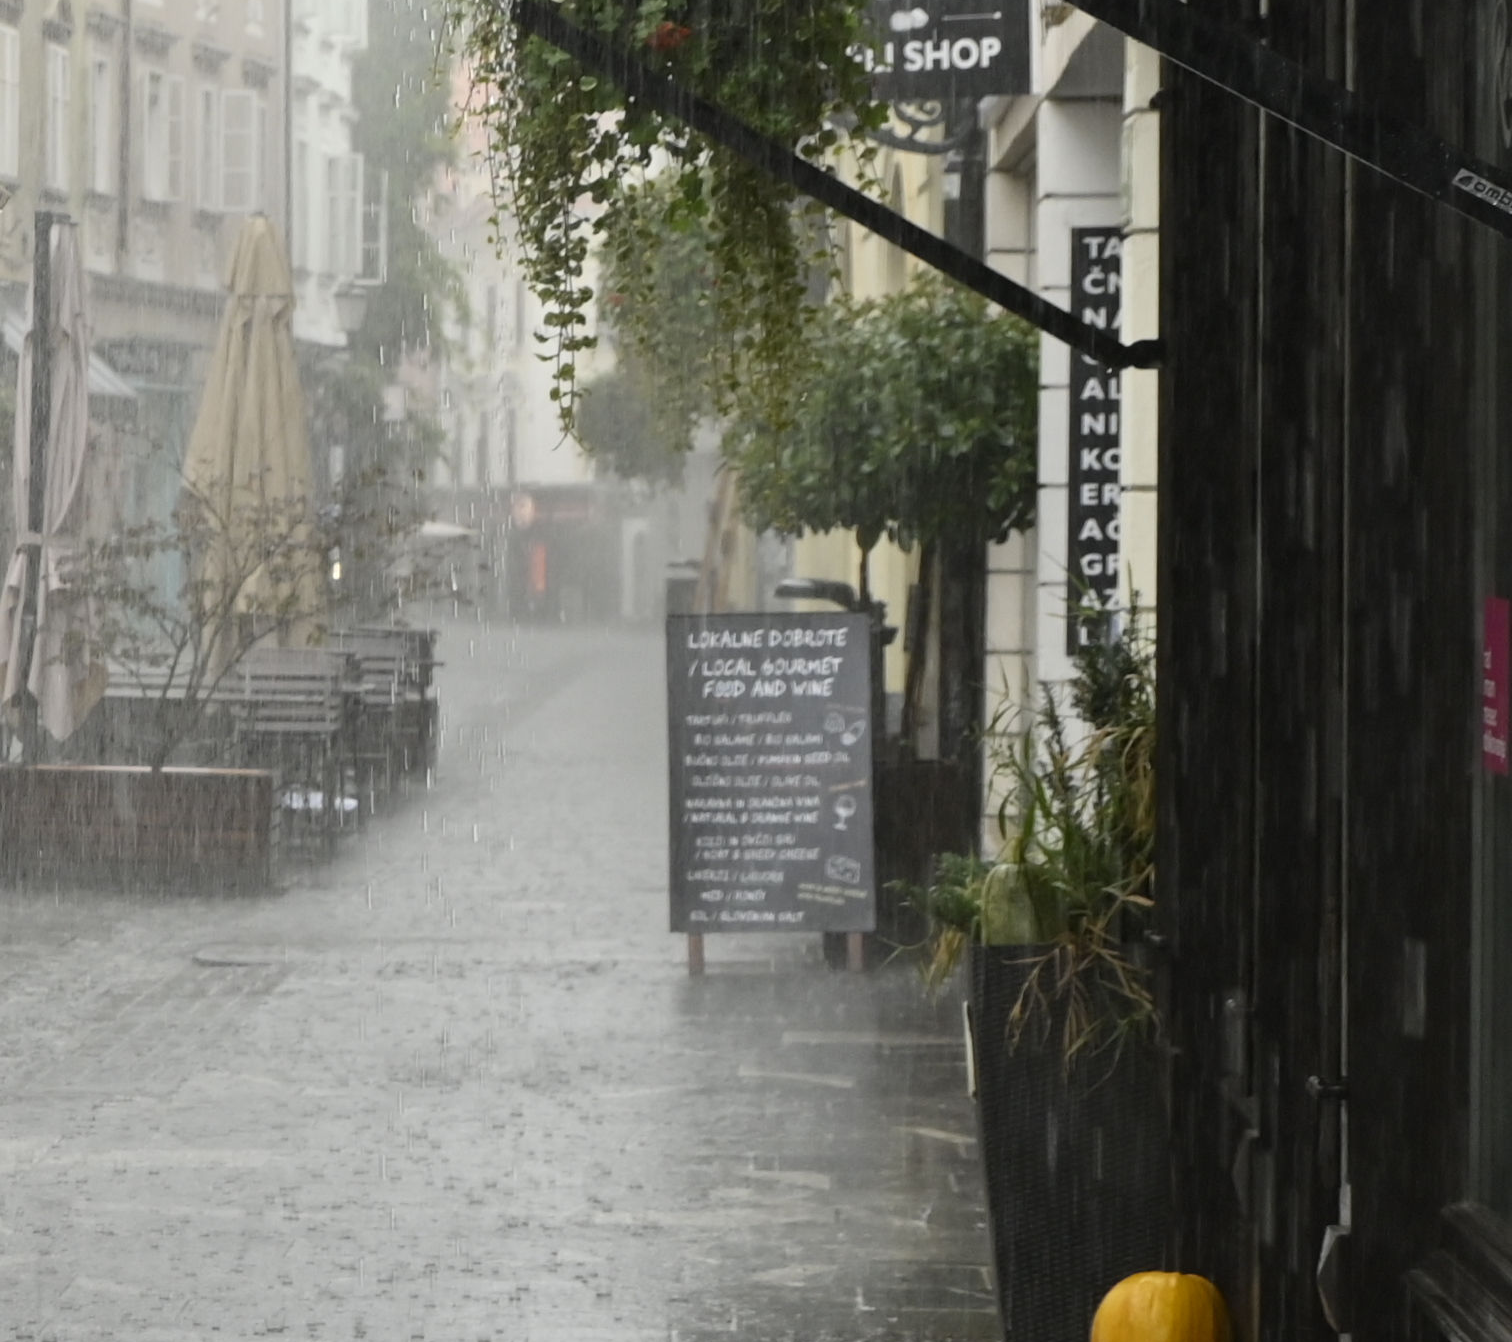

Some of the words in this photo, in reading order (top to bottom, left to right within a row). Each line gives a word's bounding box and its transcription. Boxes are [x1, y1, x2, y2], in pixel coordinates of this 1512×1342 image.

[903, 36, 1002, 71] SHOP
[688, 629, 764, 649] LOKALNE
[768, 627, 848, 647] DOBROTE
[702, 659, 756, 676] LOCAL
[760, 656, 843, 676] GOURMET
[702, 679, 745, 699] FOOD
[751, 678, 786, 698] AND
[791, 677, 835, 697] WINE
